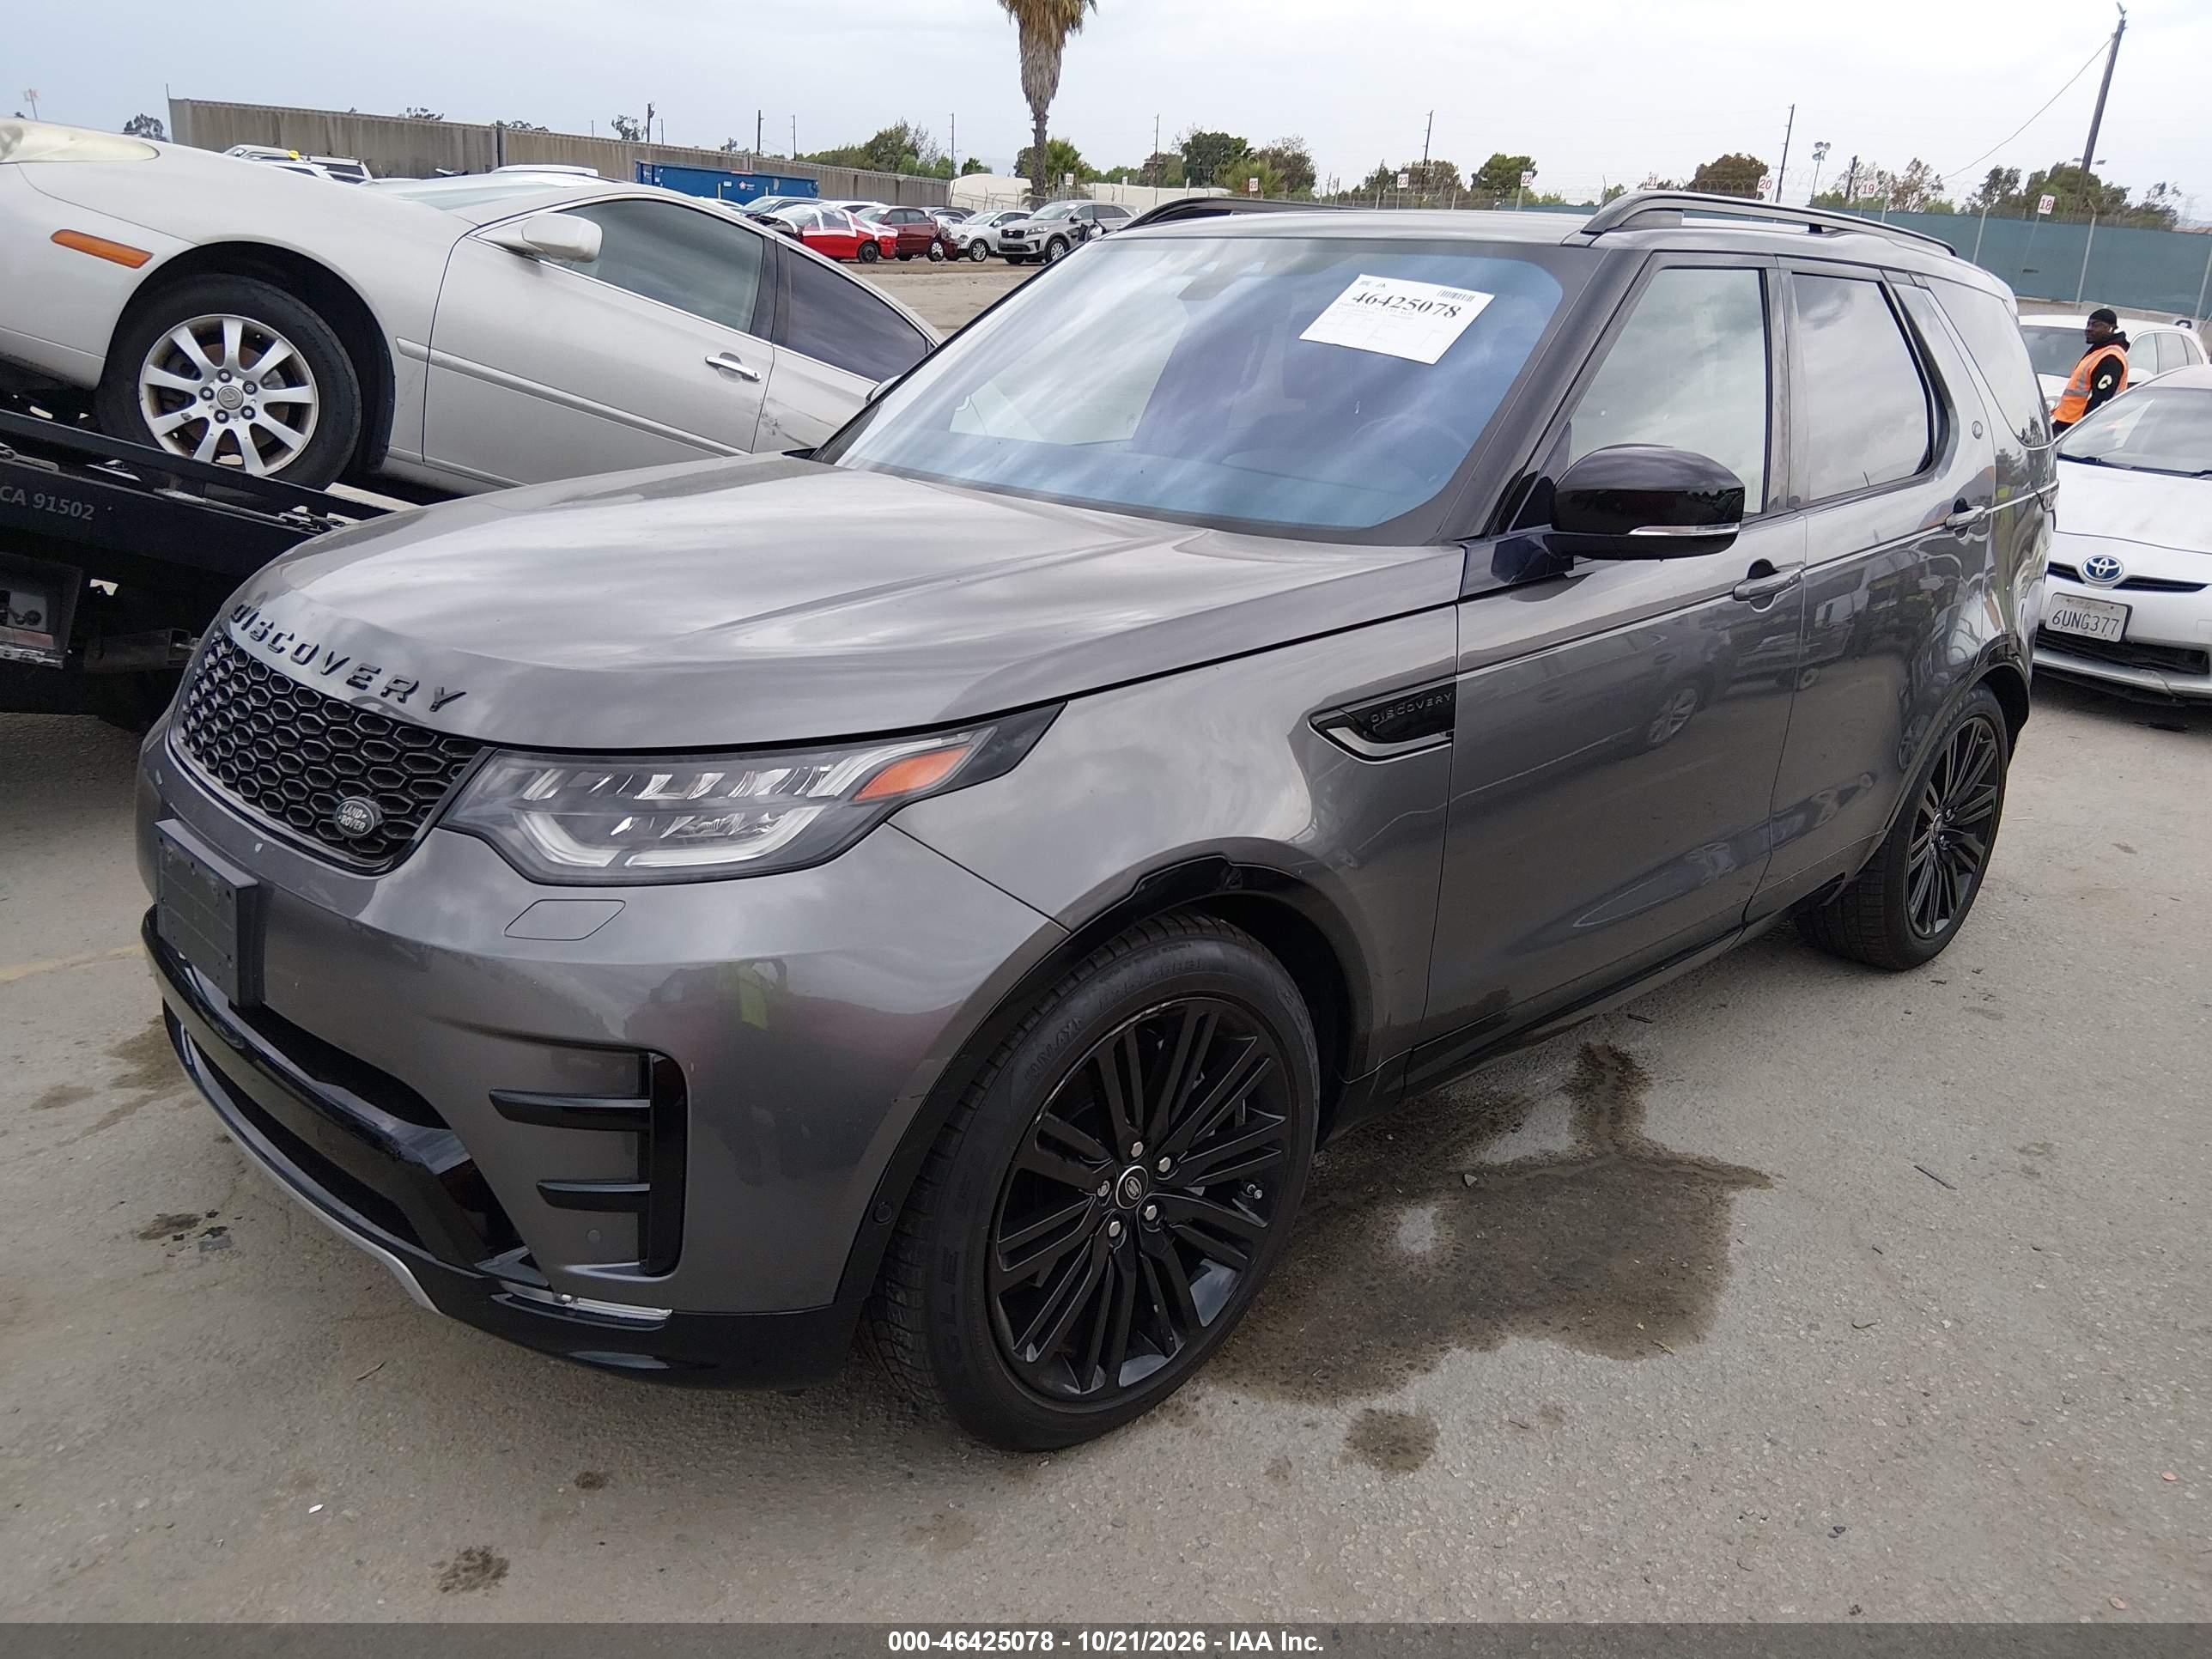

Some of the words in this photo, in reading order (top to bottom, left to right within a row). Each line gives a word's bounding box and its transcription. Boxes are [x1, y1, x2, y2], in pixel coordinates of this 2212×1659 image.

[1522, 174, 1531, 183] 22
[1648, 176, 1656, 185] 21
[1759, 179, 1771, 189] 20
[1863, 184, 1874, 193] 19
[2039, 198, 2051, 210] 18
[1352, 291, 1462, 319] 46425078
[0, 485, 27, 506] CA
[33, 493, 95, 520] 91502
[2051, 609, 2120, 635] 6UNG377
[230, 604, 467, 713] DISCOVERY
[1370, 692, 1452, 724] DISCOVERY
[340, 815, 366, 832] ROVER
